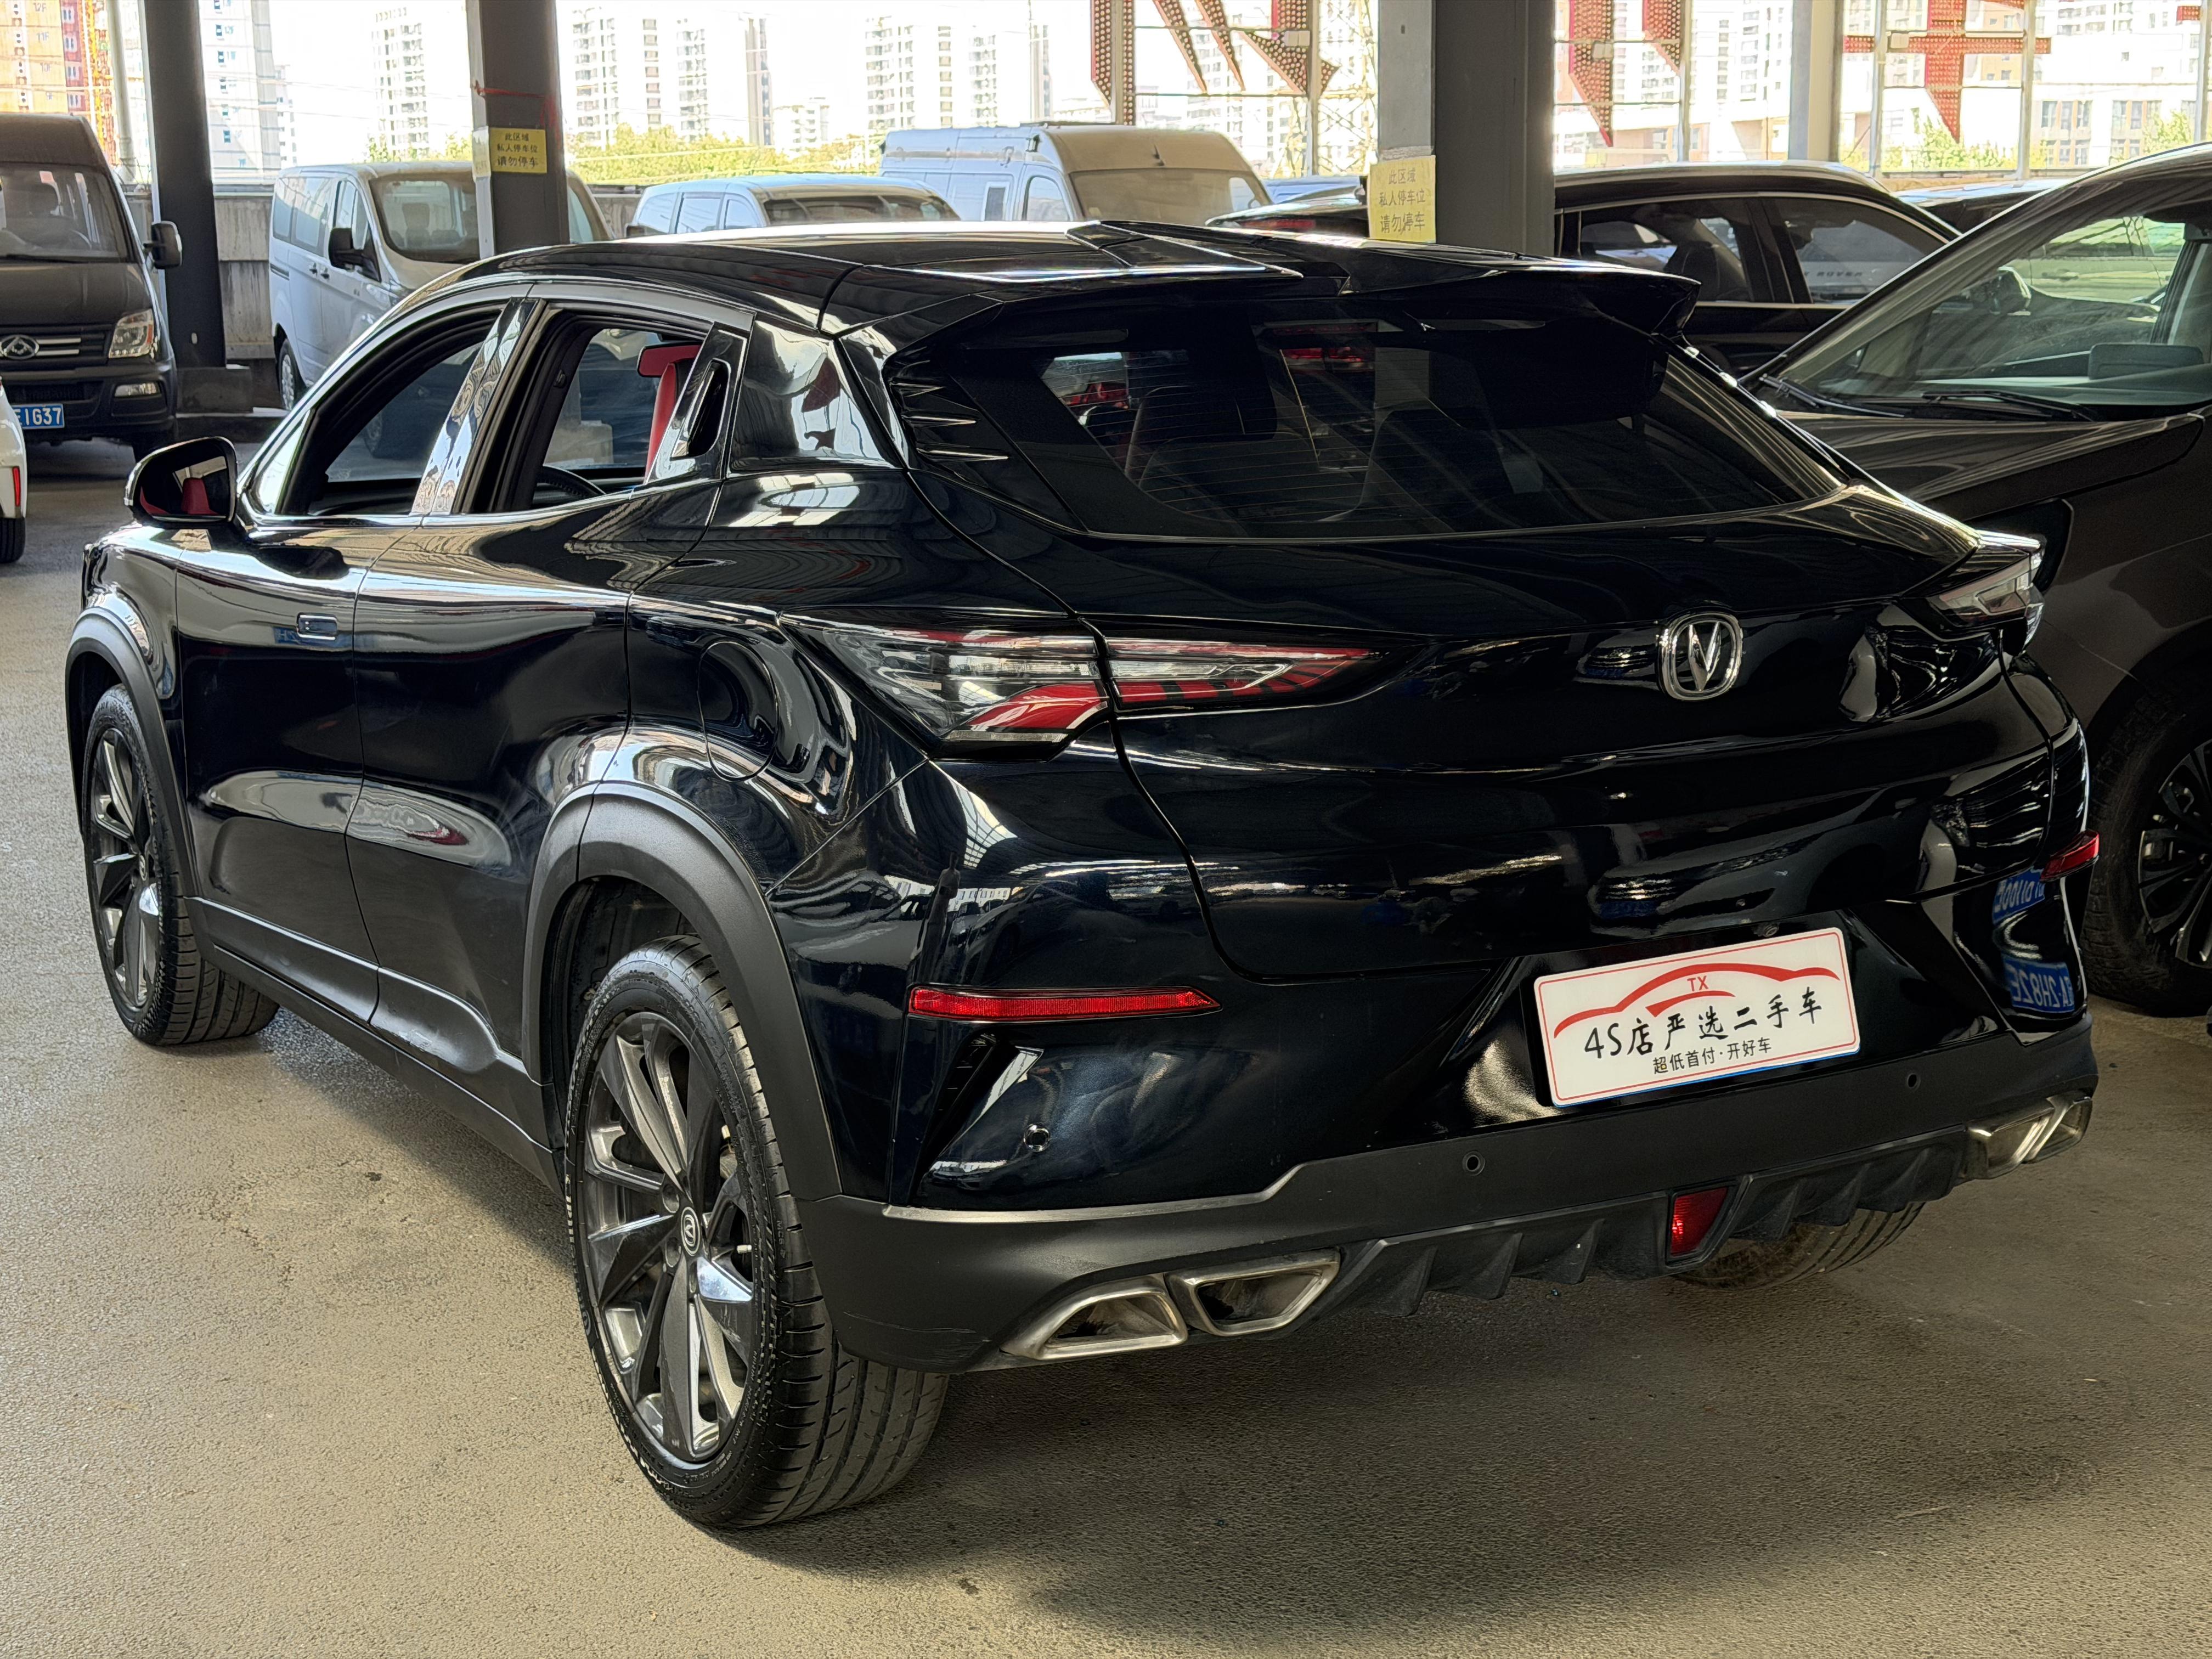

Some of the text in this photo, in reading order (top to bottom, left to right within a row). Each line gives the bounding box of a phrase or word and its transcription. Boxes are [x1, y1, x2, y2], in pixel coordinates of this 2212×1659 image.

[505, 133, 529, 142] 此区域
[497, 144, 538, 153] 私人停车位
[498, 156, 538, 168] 请勿停车
[1389, 167, 1416, 184] 此区域
[1379, 189, 1426, 207] 私人停车位
[1380, 211, 1425, 234] 请勿停车
[1687, 975, 1709, 991] TX
[1584, 986, 1822, 1059] 4S店严选二手车
[1653, 1037, 1772, 1075] 超低首付·开好车
